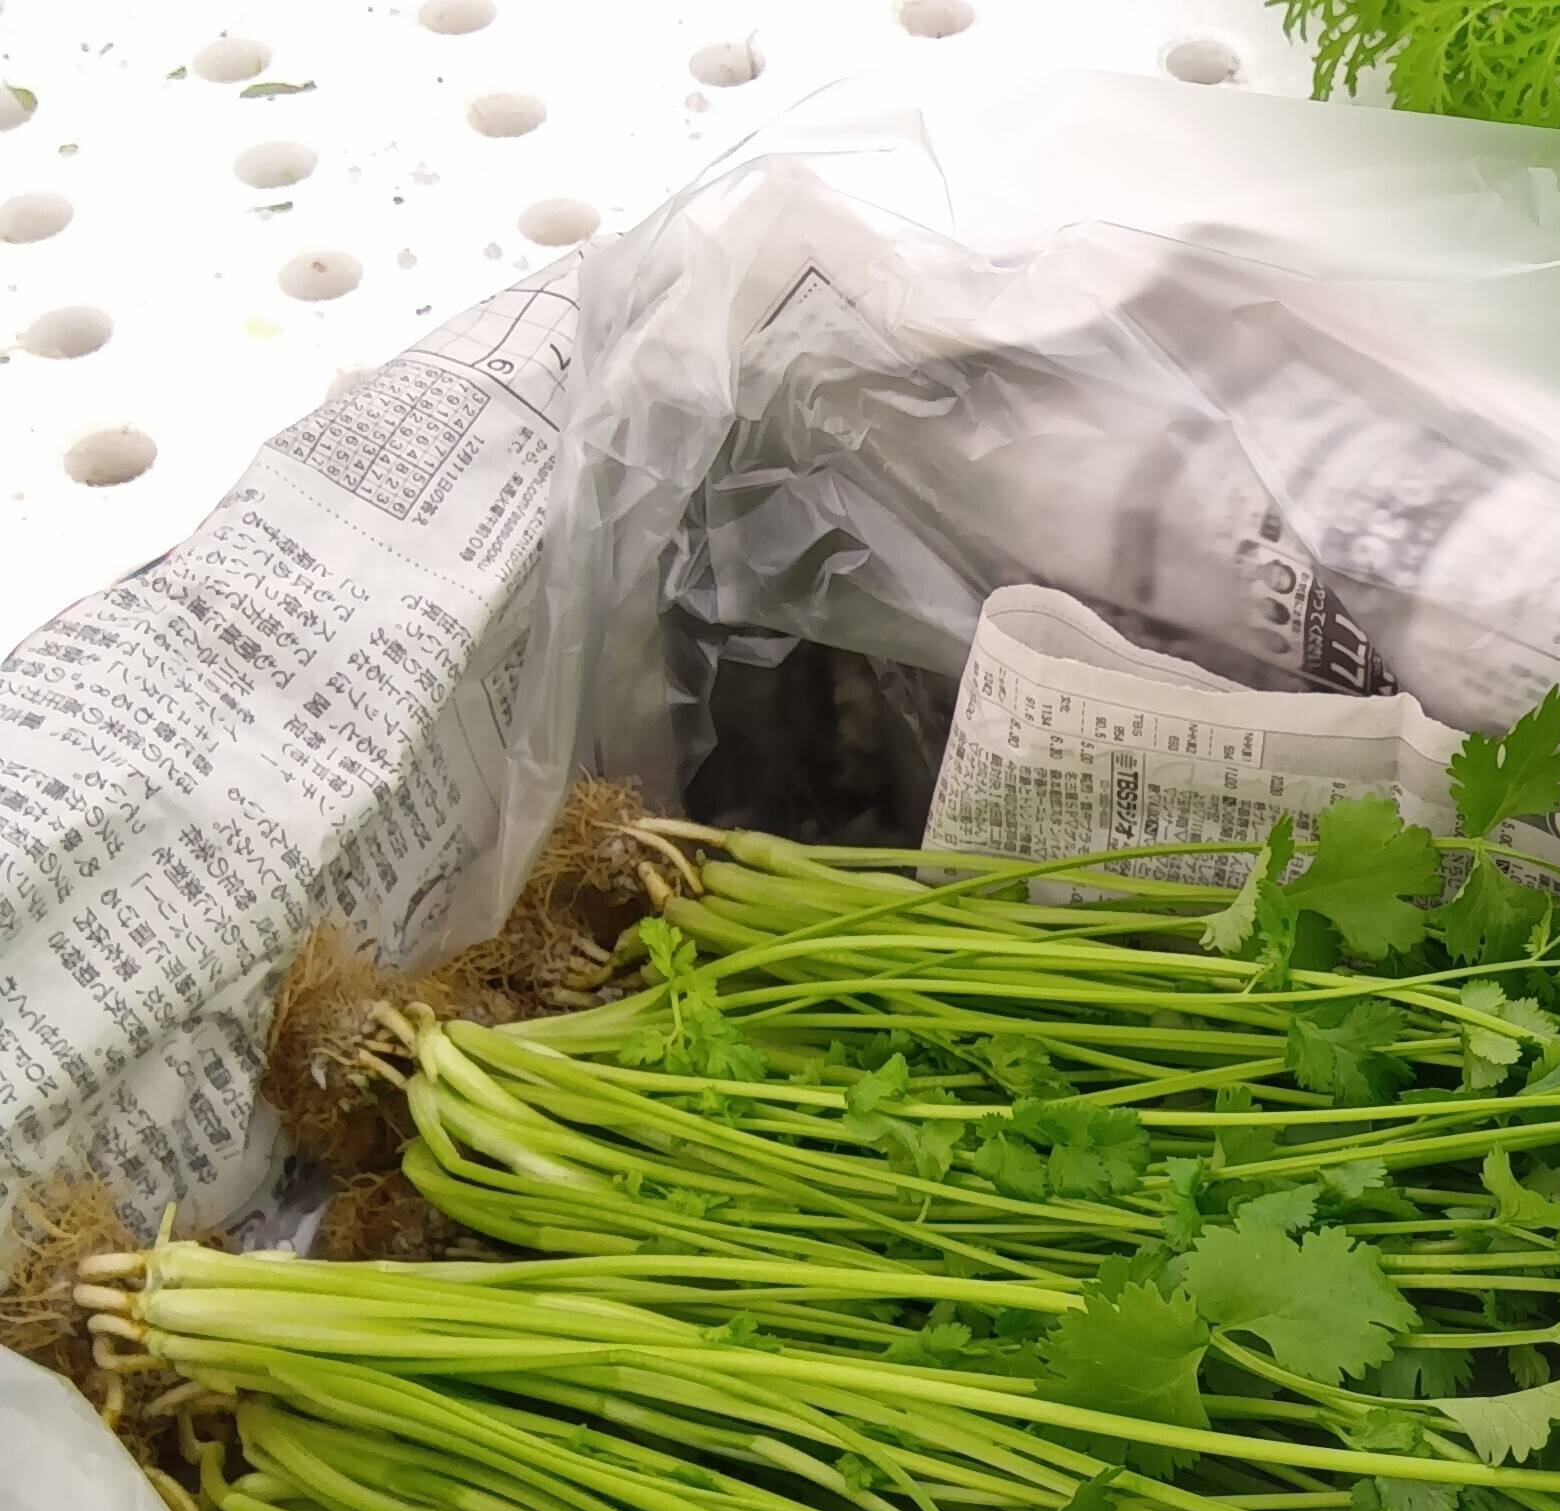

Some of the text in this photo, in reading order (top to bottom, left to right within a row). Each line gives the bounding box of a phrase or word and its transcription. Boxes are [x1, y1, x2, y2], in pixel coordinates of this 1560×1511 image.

[487, 357, 515, 375] 6
[411, 435, 485, 526] 12月11日の答え
[1132, 714, 1142, 736] TBS
[1115, 772, 1137, 838] TBSラジオ
